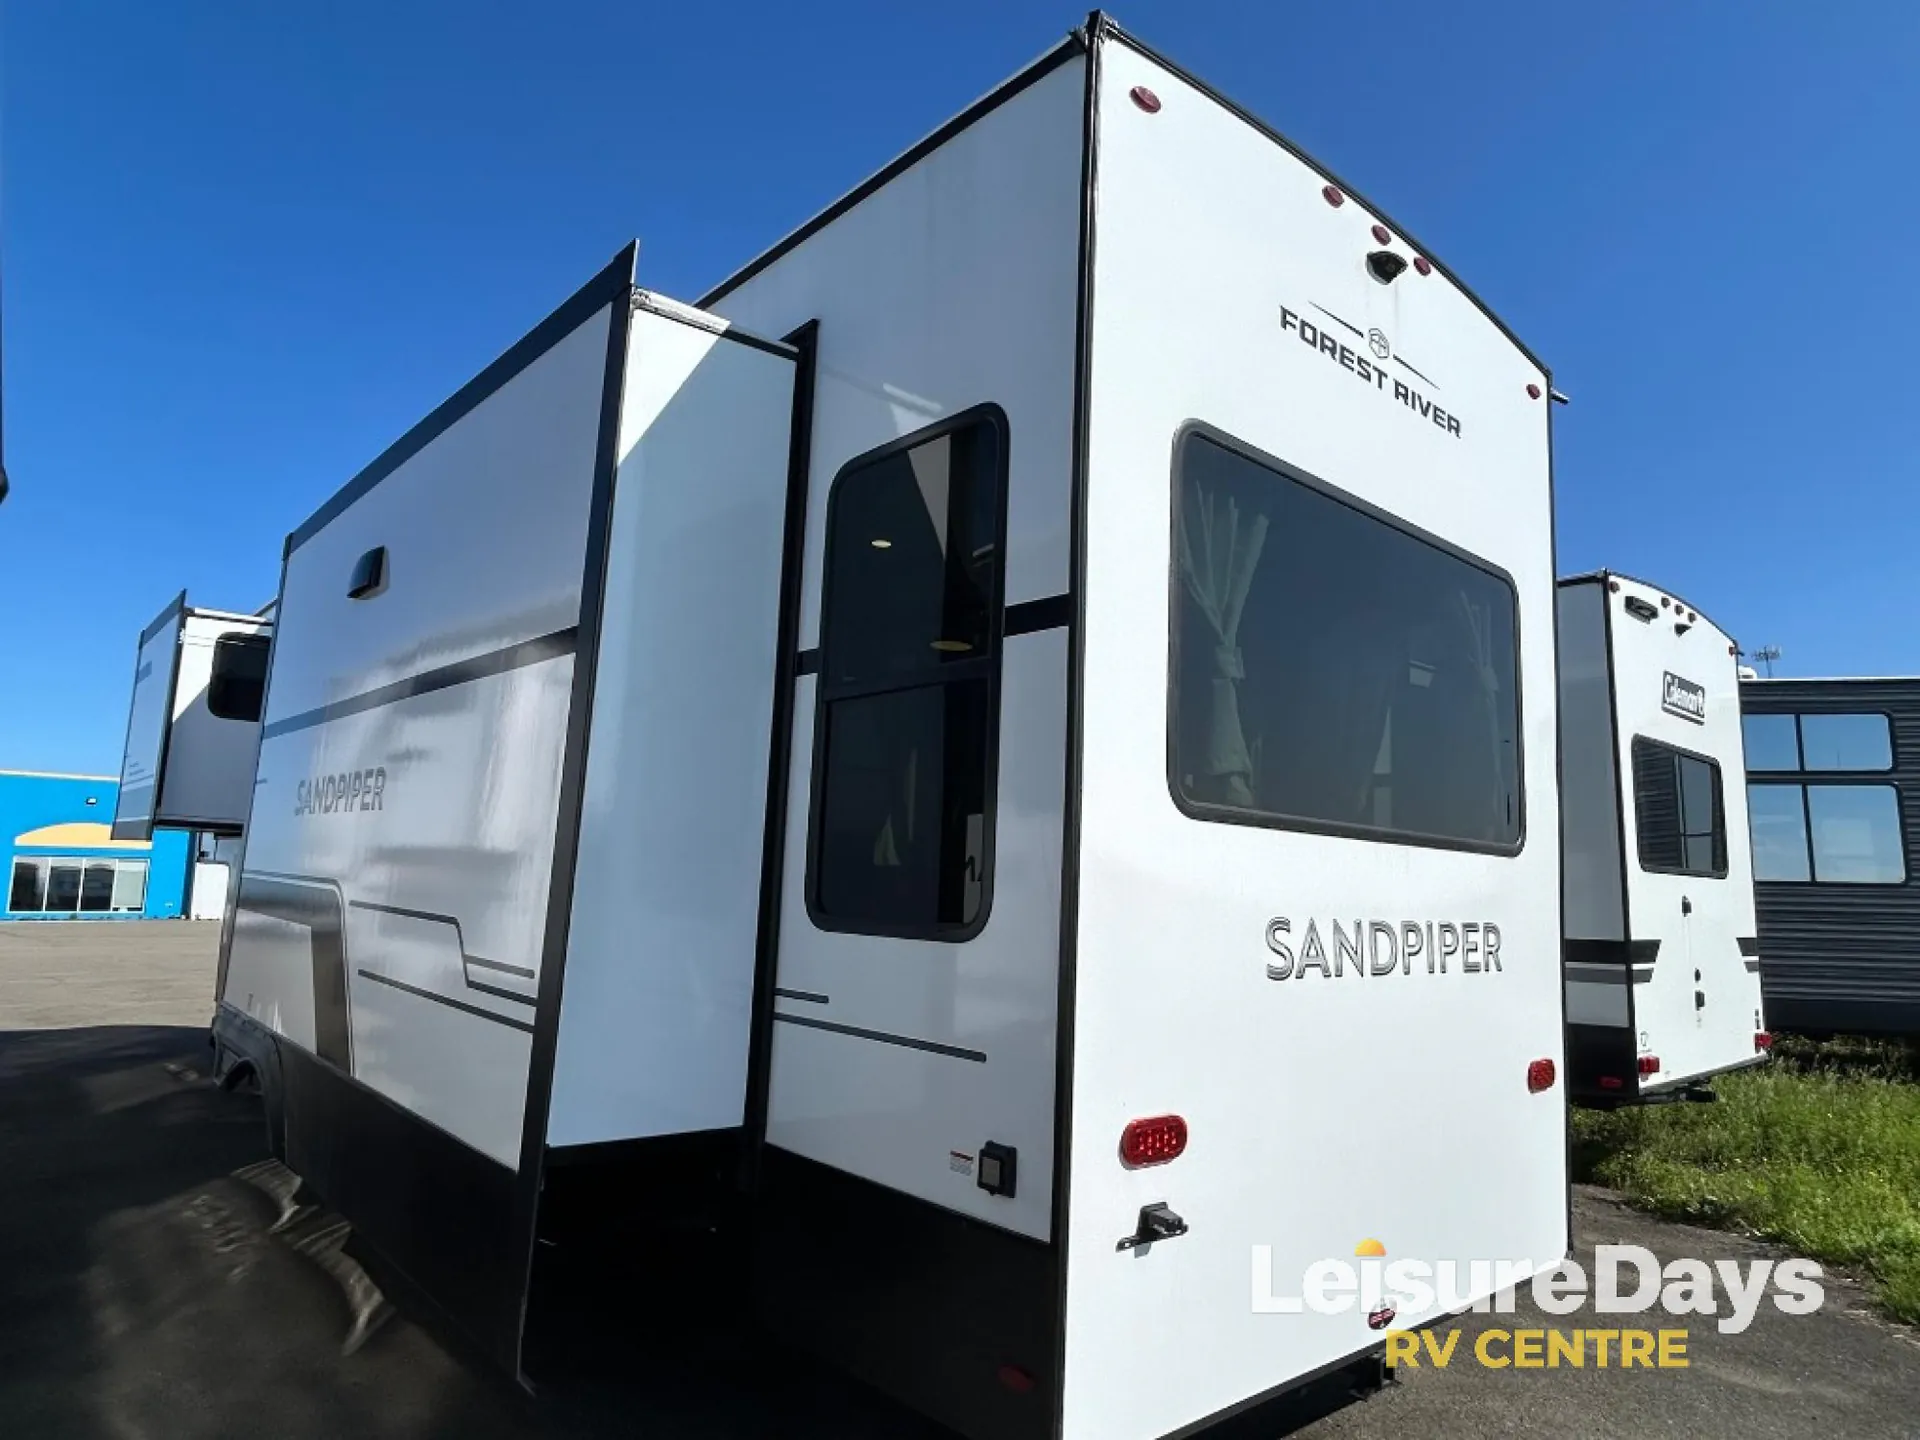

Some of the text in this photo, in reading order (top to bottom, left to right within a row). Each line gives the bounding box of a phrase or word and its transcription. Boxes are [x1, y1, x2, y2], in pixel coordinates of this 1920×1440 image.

[1279, 305, 1388, 390] FOREST
[1393, 378, 1461, 439] RIVER
[294, 766, 386, 816] SANDPIPER
[1265, 916, 1503, 981] SANDPIPER
